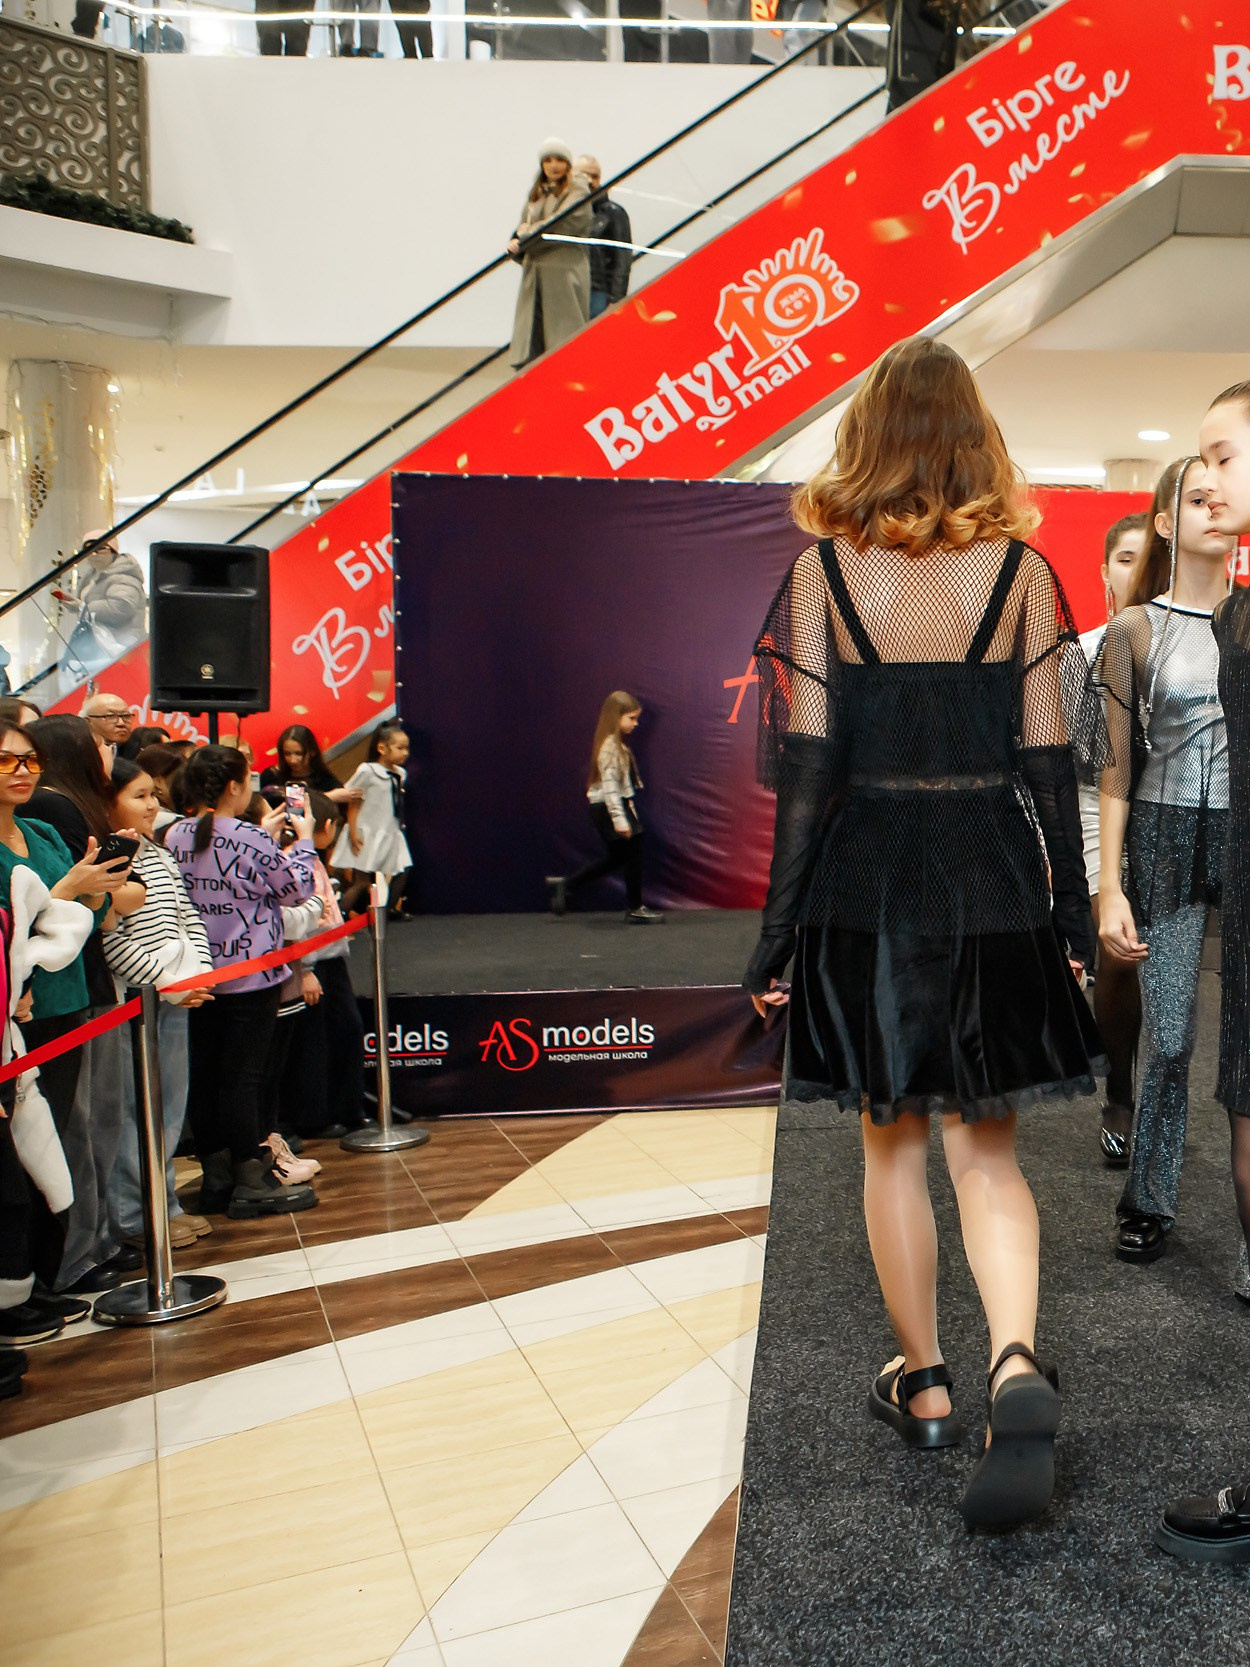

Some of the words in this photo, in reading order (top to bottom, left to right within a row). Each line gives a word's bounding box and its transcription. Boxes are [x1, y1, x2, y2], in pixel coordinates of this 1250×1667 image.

[966, 60, 1086, 149] Бірге
[922, 69, 1131, 255] Вместе
[735, 344, 812, 409] mall
[583, 342, 746, 471] Batyr
[334, 533, 393, 591] Бір
[209, 930, 252, 959] OUIS
[364, 1023, 449, 1053] odels
[542, 1017, 655, 1047] models
[404, 1058, 443, 1067] школа
[548, 1051, 611, 1064] модельная
[612, 1051, 648, 1060] школа
